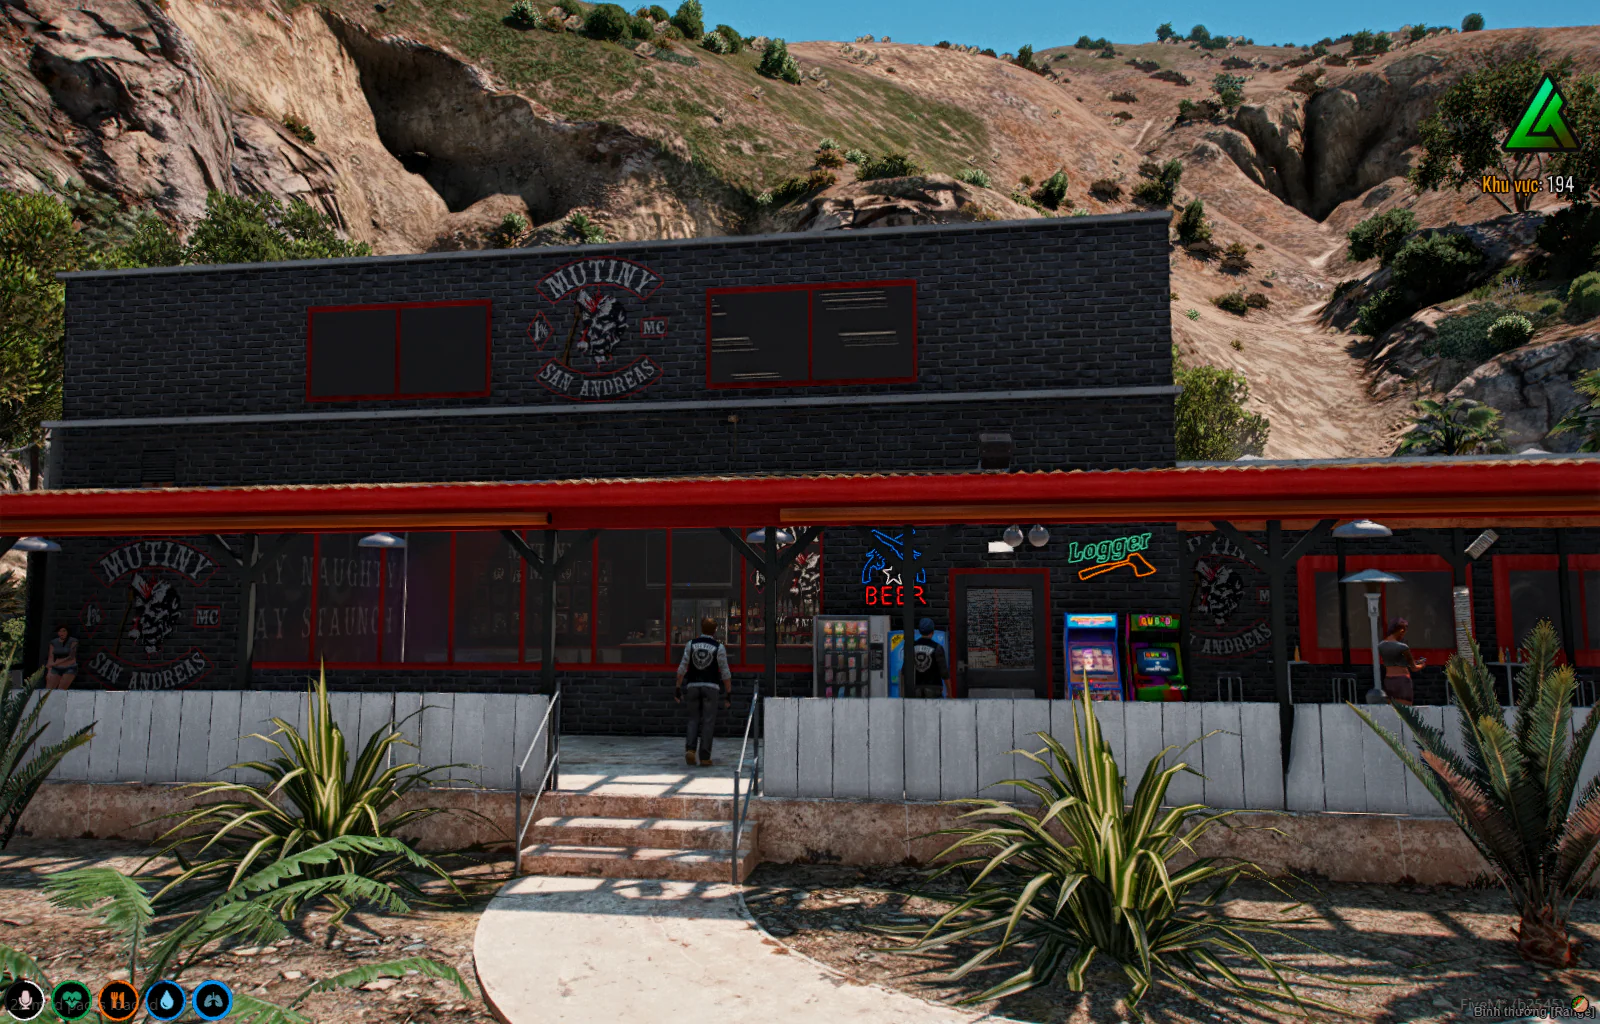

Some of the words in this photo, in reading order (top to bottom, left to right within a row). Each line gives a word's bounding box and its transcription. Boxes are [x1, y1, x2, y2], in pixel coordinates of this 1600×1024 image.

[545, 259, 656, 299] MUTINY
[642, 320, 666, 335] MC
[539, 363, 574, 391] SAN
[580, 359, 655, 397] ANDREAS
[99, 540, 213, 583] MUTINY
[1067, 532, 1152, 563] Logger
[865, 585, 927, 606] BEER
[196, 608, 219, 625] MC
[254, 607, 288, 640] AY
[1201, 623, 1272, 655] ANDREAS
[89, 651, 124, 684] SAN
[128, 651, 206, 690] ANDREAS
